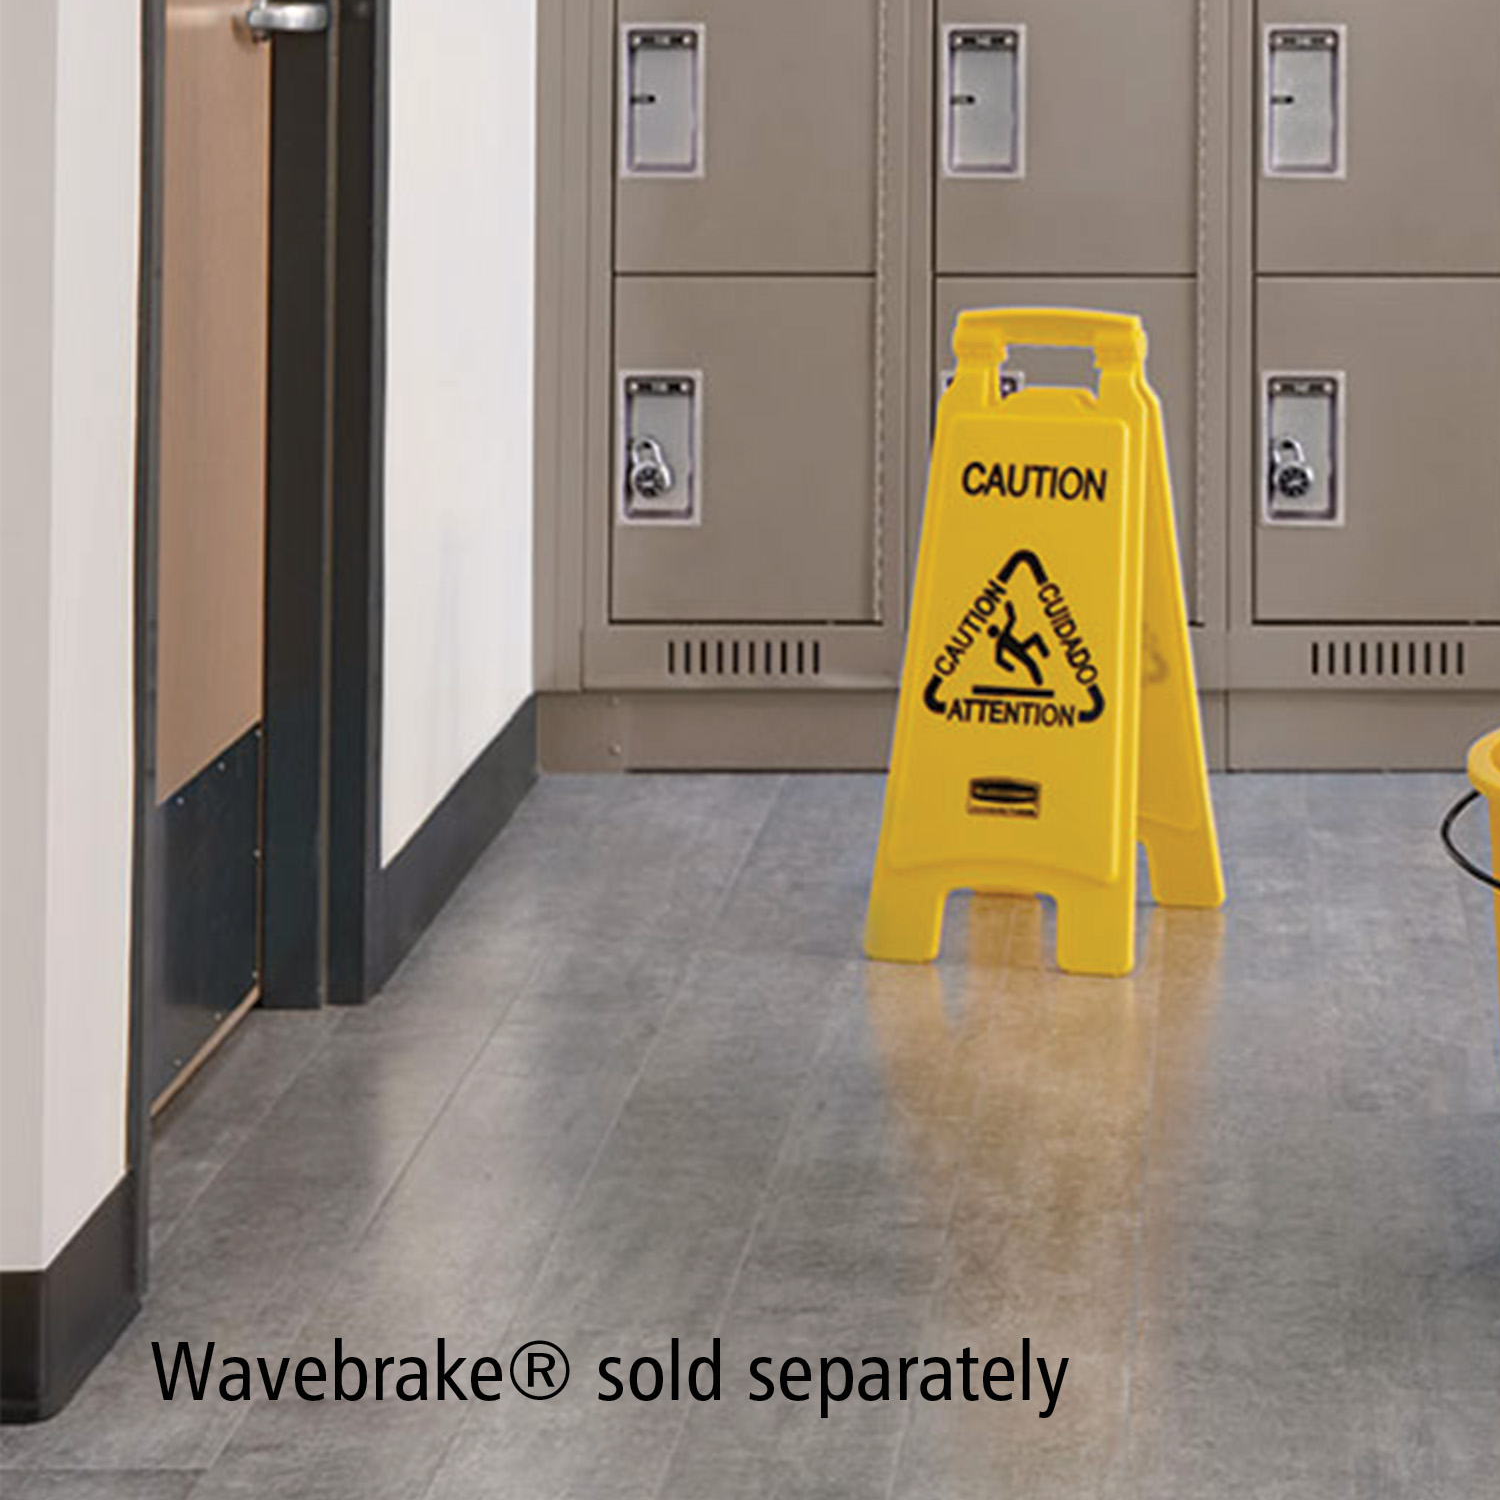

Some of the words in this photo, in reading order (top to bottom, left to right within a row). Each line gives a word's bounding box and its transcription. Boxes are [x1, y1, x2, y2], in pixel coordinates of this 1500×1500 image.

[961, 461, 1107, 502] CAUTION
[934, 578, 1008, 676] CAUTION
[1037, 582, 1098, 686] CUIDADO
[946, 698, 1076, 728] ATTENTION
